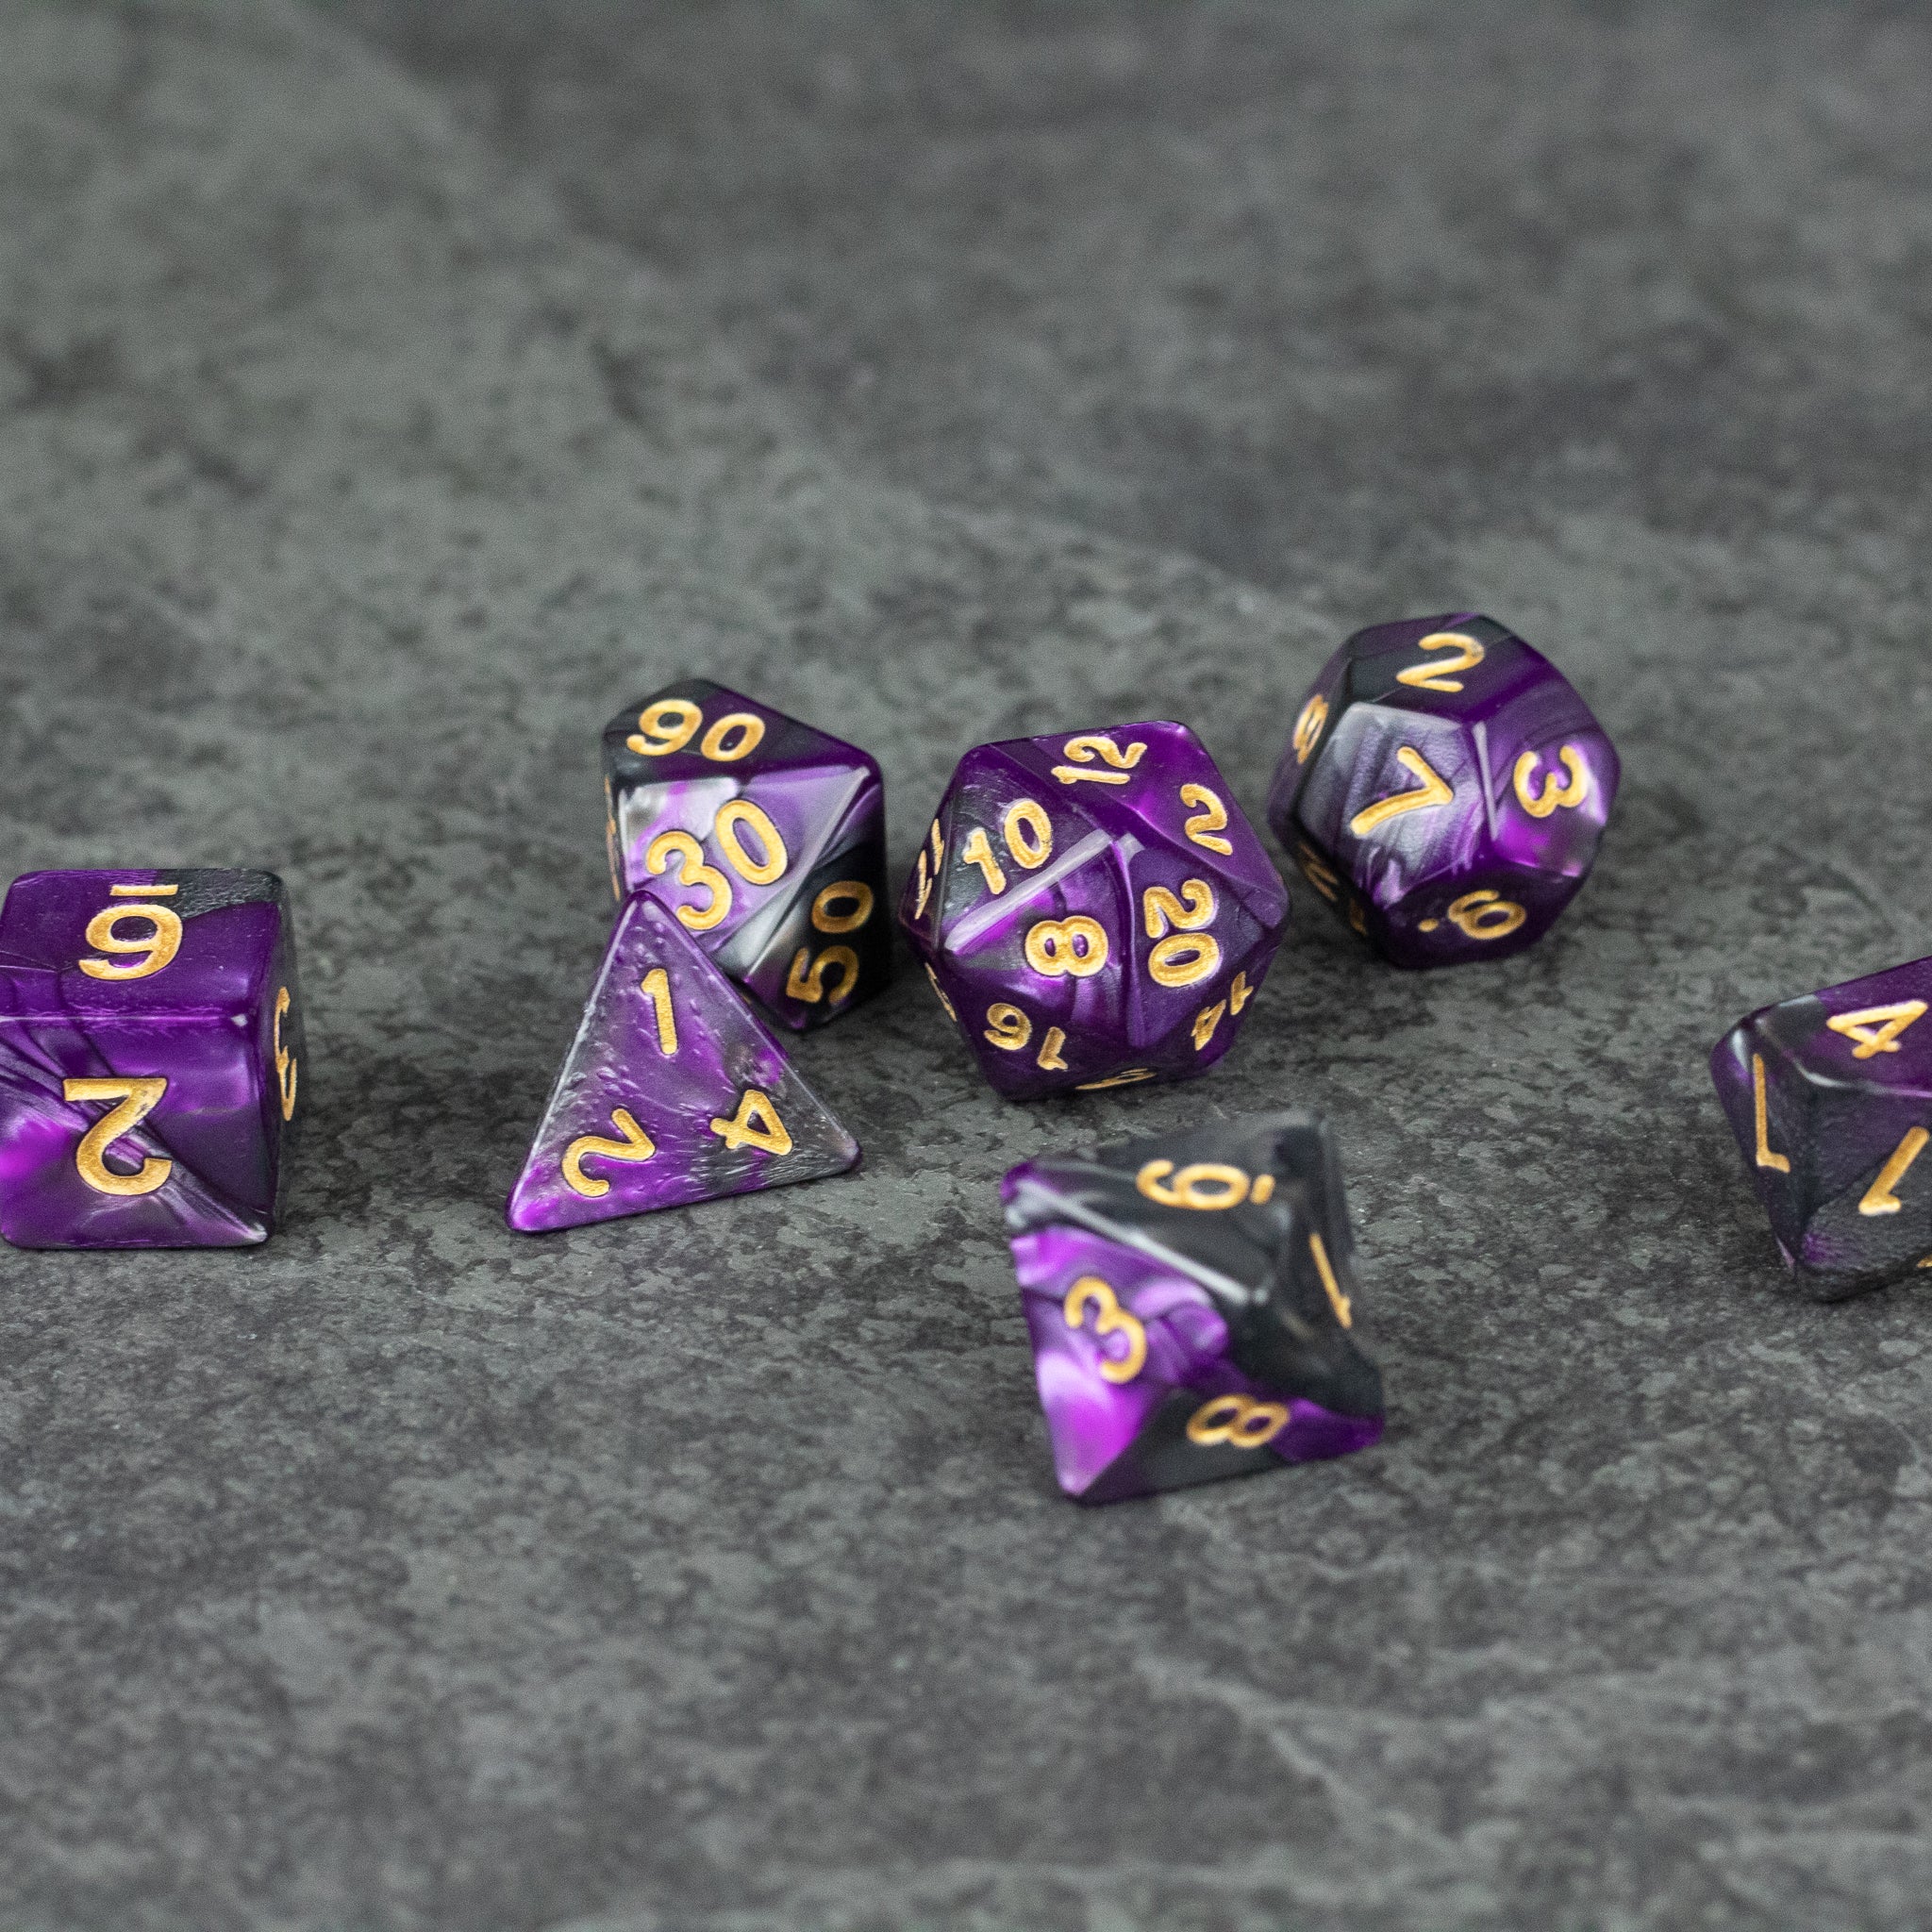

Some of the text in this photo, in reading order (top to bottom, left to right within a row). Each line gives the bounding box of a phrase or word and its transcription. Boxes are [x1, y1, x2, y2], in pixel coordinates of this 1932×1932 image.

[1395, 632, 1485, 693] 2
[625, 699, 766, 762] 90
[1051, 736, 1148, 785] 12
[1180, 783, 1234, 856] 2
[1349, 745, 1455, 837] 7
[1513, 745, 1589, 819] 3
[646, 799, 789, 931] 30
[963, 798, 1054, 896] 10
[786, 879, 874, 1005] 50
[1024, 914, 1110, 977] 8
[1142, 877, 1221, 988] 20
[641, 967, 679, 1055] 1
[1825, 998, 1929, 1059] 4
[61, 1077, 173, 1195] 2
[560, 1107, 657, 1198] 2
[709, 1088, 794, 1156] 4
[1062, 1274, 1148, 1384] 3
[1185, 1392, 1291, 1449] 8
